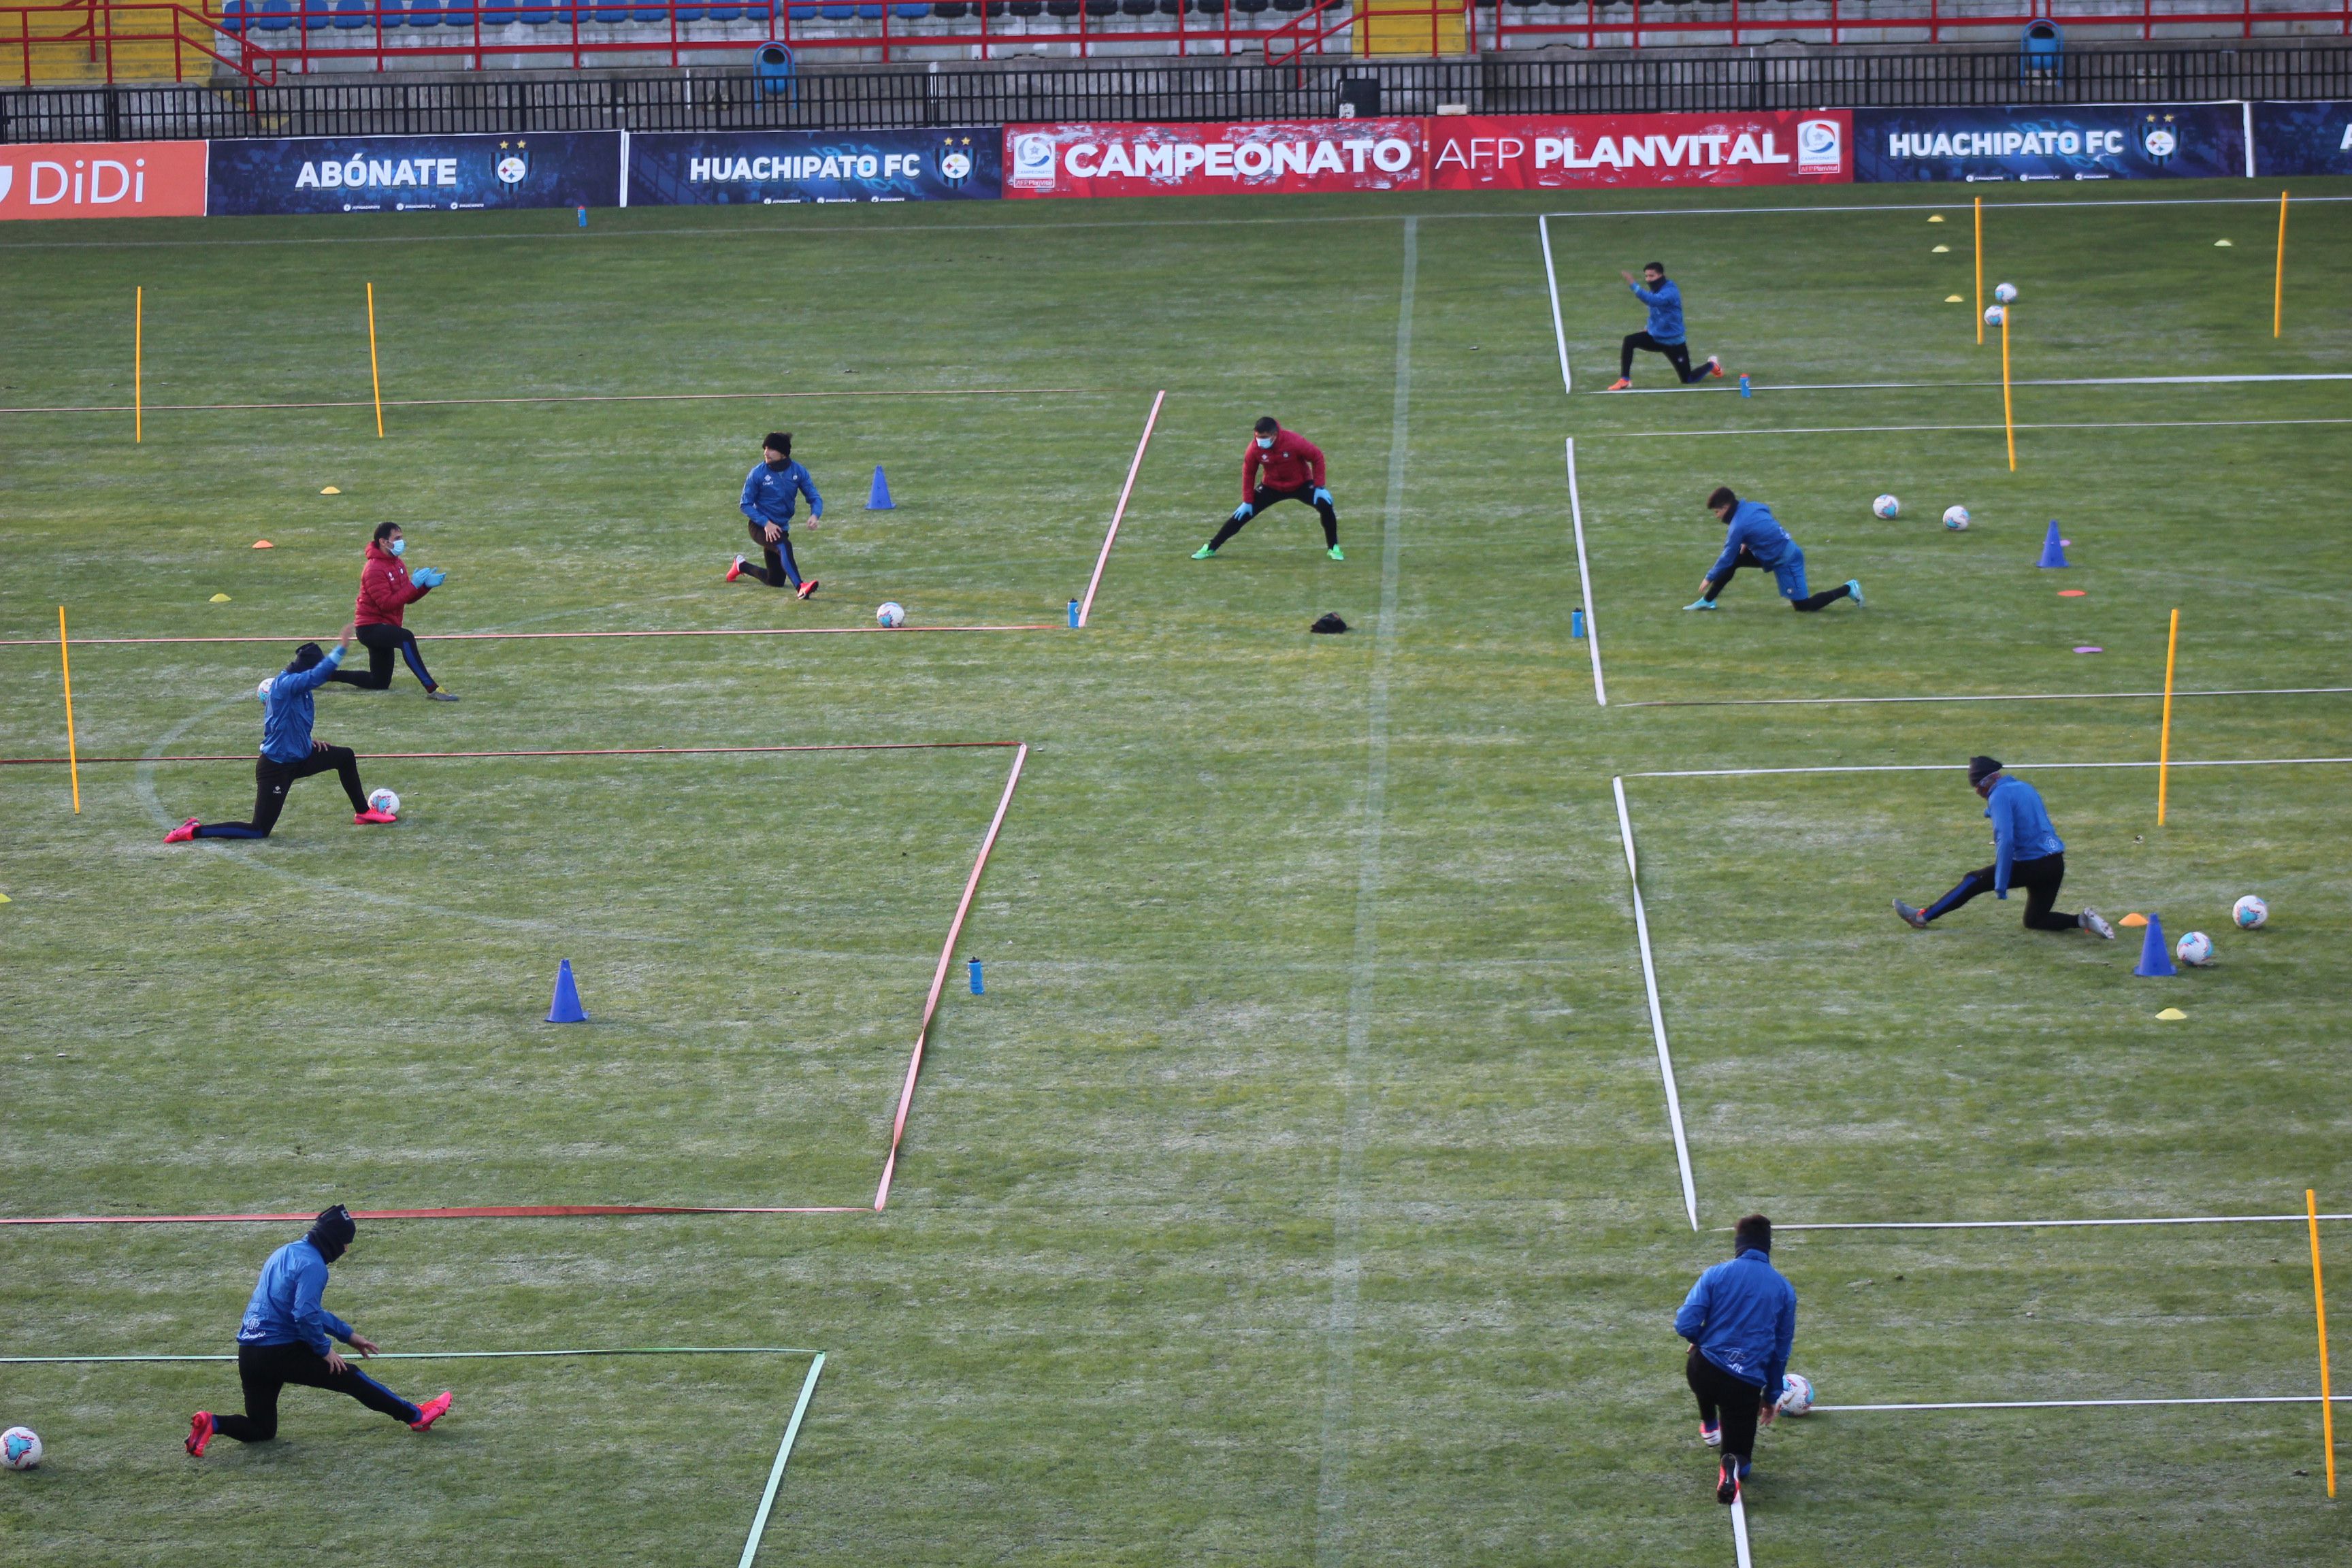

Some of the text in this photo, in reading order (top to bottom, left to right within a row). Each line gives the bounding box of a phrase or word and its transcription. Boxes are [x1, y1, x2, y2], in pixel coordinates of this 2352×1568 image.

[1065, 138, 1411, 178] CAMPEONATO
[1435, 133, 1788, 169] AFP PLANVITAL
[1889, 131, 2123, 157] HUACHIPATO FC
[30, 159, 145, 204] DiDi
[295, 153, 457, 189] ABÓNATE
[690, 154, 920, 180] HUACHIPATO FC
